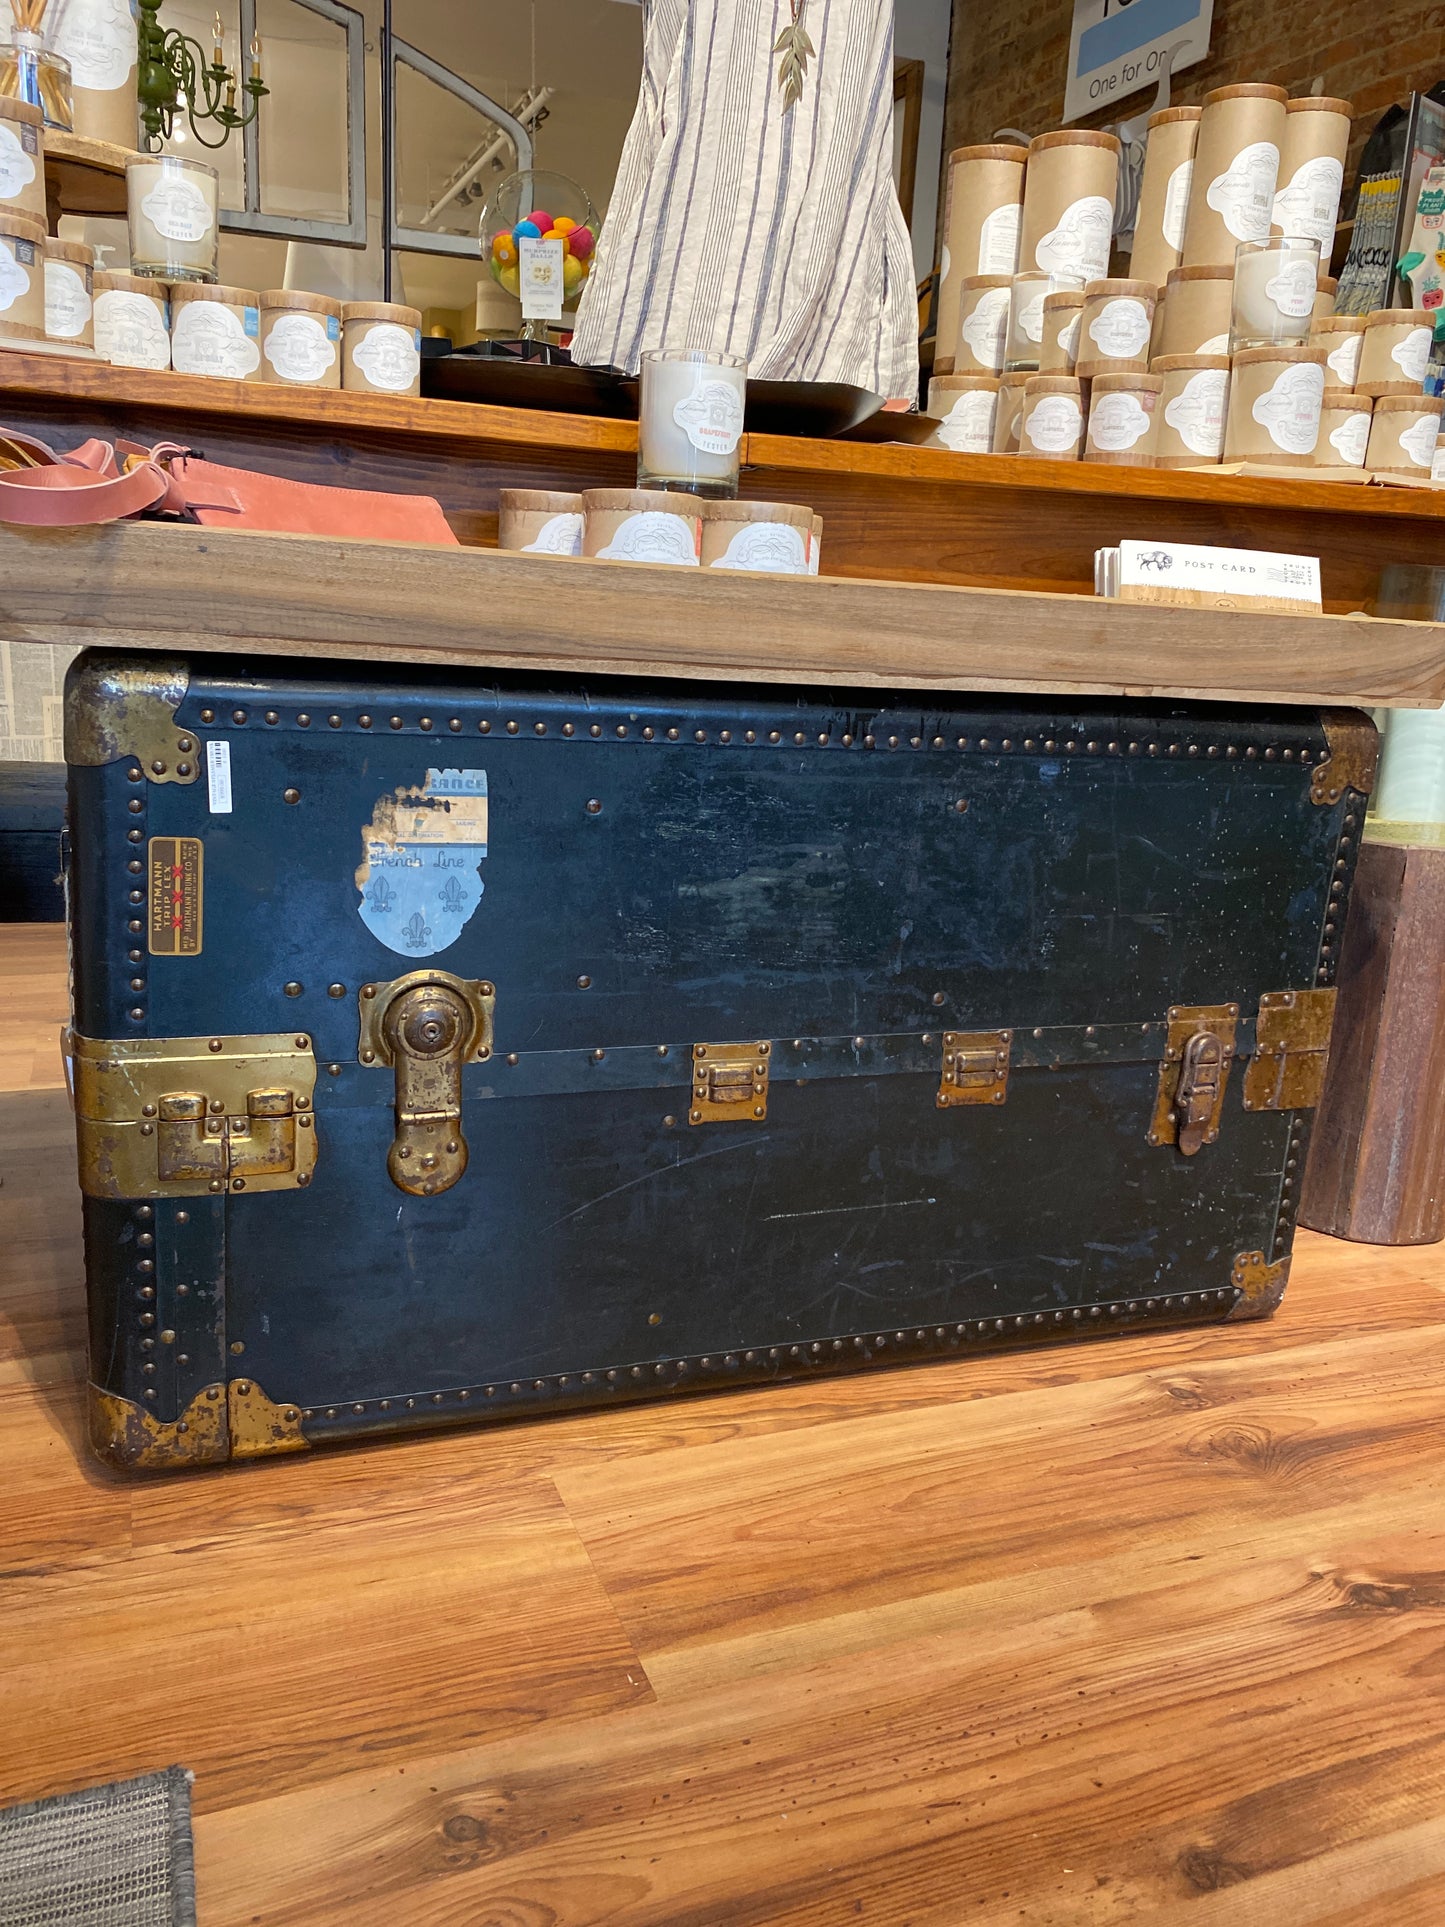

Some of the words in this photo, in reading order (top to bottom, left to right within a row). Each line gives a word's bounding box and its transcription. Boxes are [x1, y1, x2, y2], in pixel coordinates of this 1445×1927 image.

[1089, 74, 1116, 99] One
[1121, 62, 1142, 84] for
[702, 440, 728, 451] TESTER
[1184, 560, 1215, 570] POST
[1221, 564, 1257, 574] CARD
[433, 850, 465, 869] Line
[163, 865, 171, 889] LEX
[184, 872, 193, 895] TRUNK
[153, 861, 163, 931] HARTMANN
[163, 896, 171, 927] TRIP
[184, 896, 193, 933] HARTMANN
